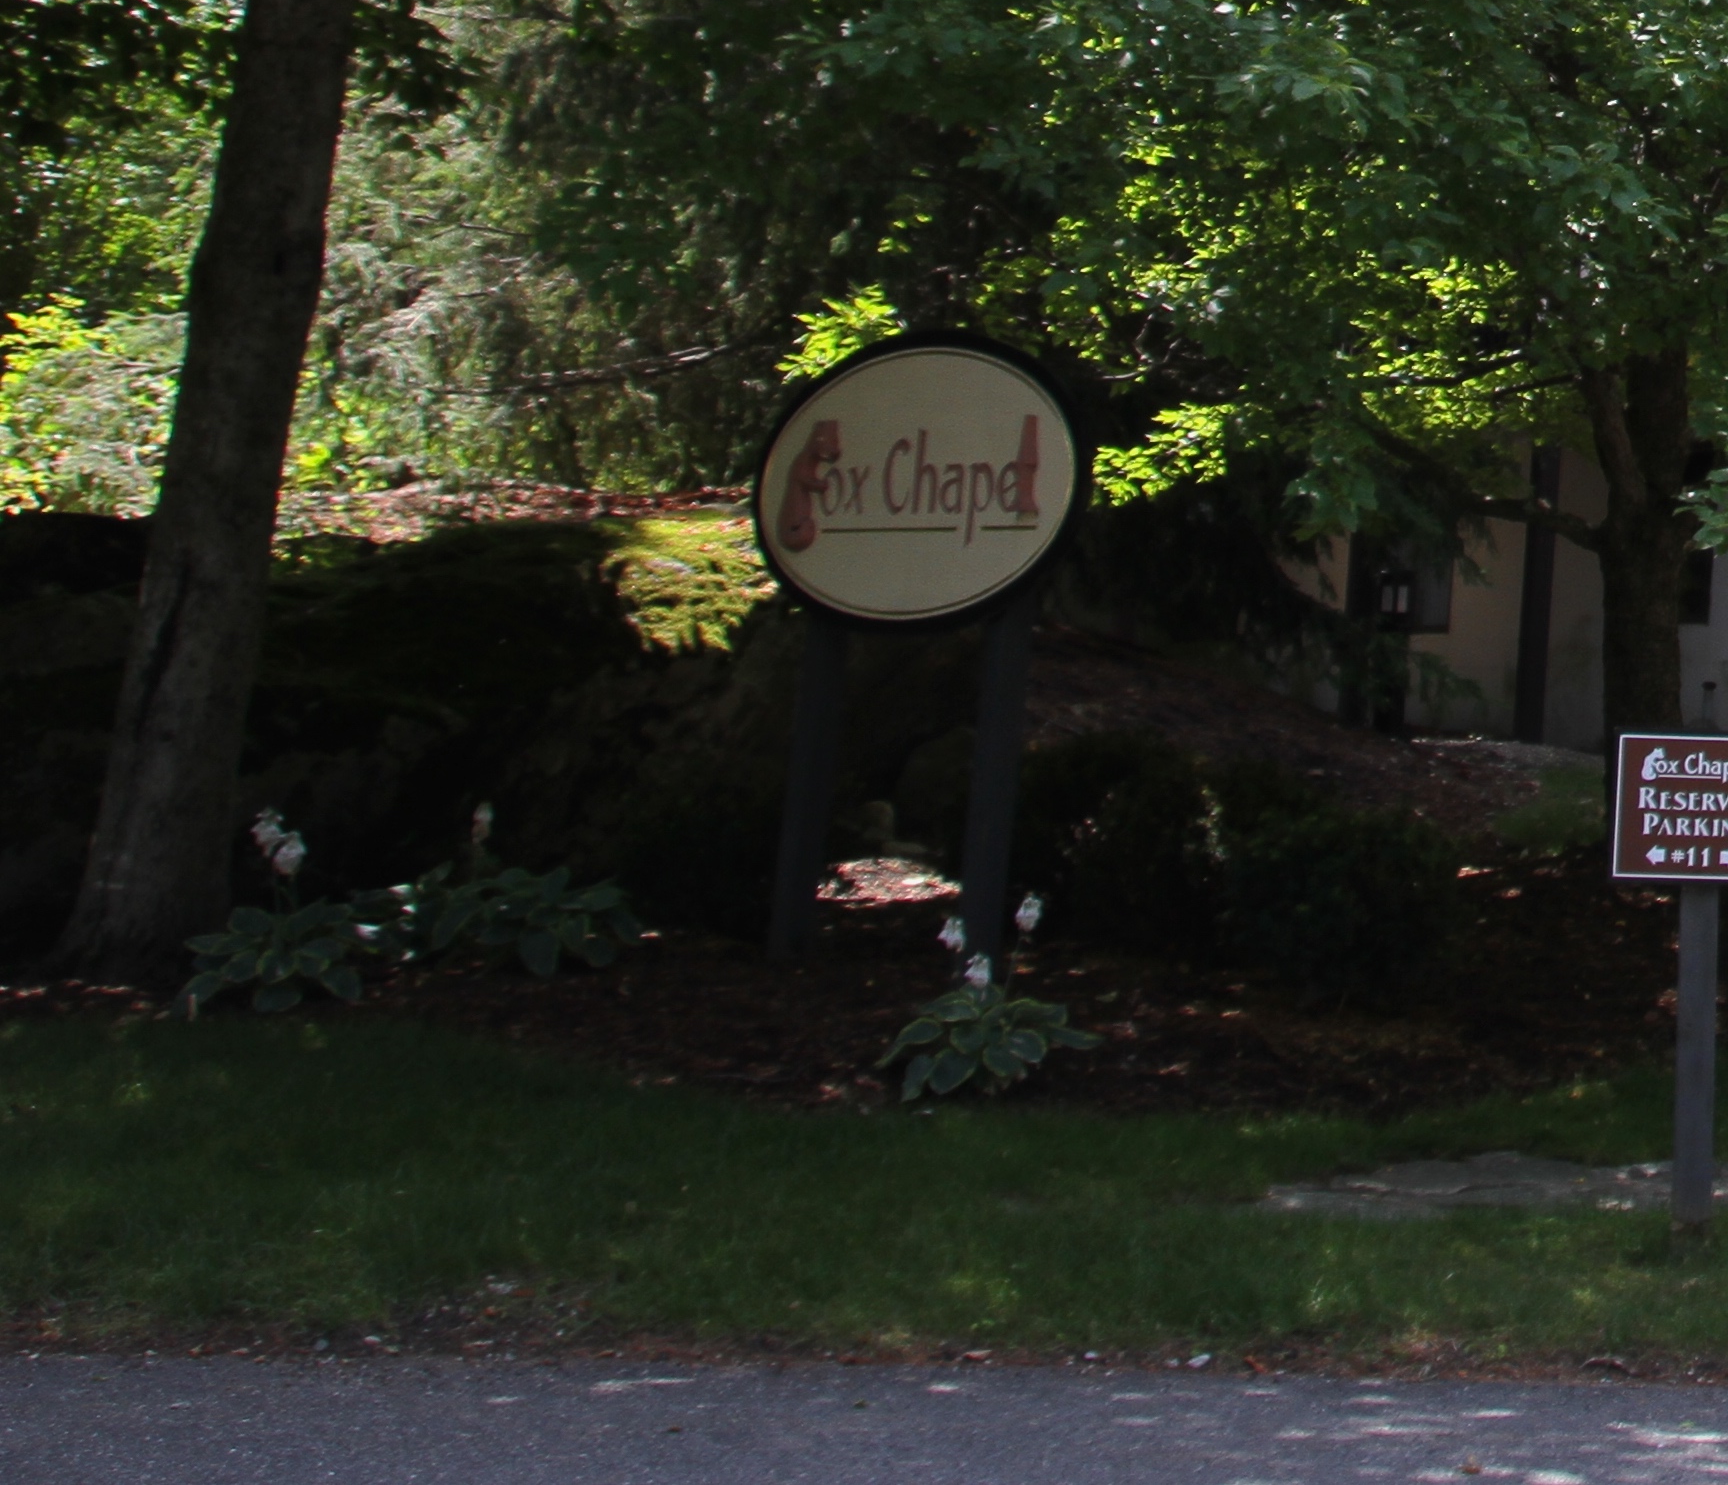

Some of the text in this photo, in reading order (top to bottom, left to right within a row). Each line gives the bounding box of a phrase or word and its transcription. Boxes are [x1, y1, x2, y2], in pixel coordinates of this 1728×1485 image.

[776, 414, 1039, 552] Fox Chapel
[1641, 748, 1679, 781] Fox
[1671, 847, 1710, 867] #11
